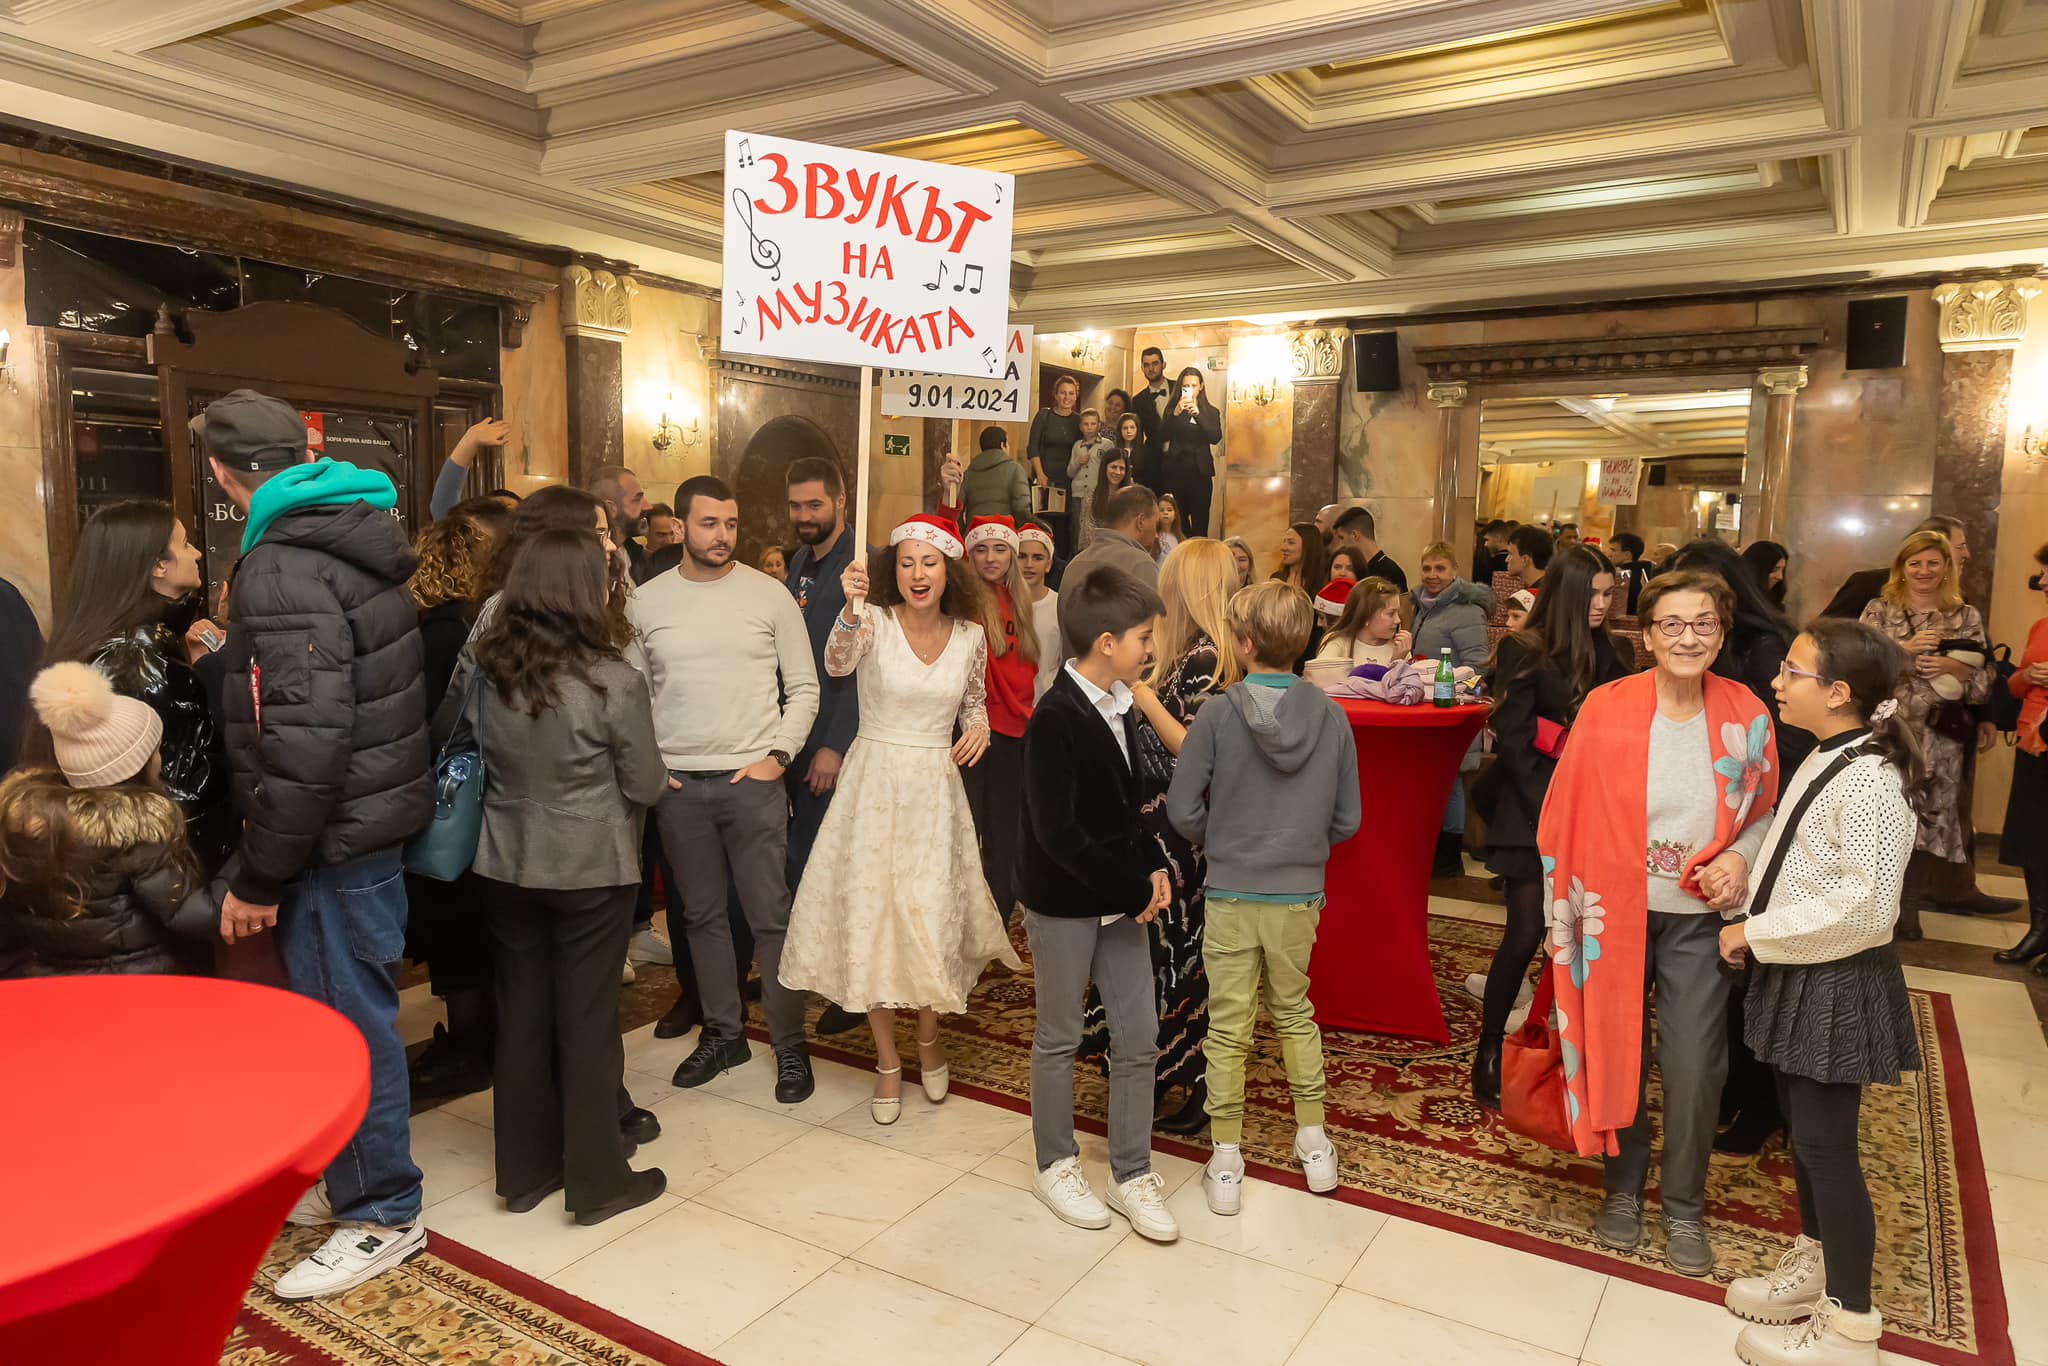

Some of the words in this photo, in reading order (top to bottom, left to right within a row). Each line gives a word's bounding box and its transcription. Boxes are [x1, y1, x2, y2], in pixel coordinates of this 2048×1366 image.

[753, 153, 993, 254] ЗВУКЪТ
[843, 241, 894, 281] НА
[756, 280, 975, 354] МУЗИКАТА
[908, 383, 1019, 413] 9.01.2024
